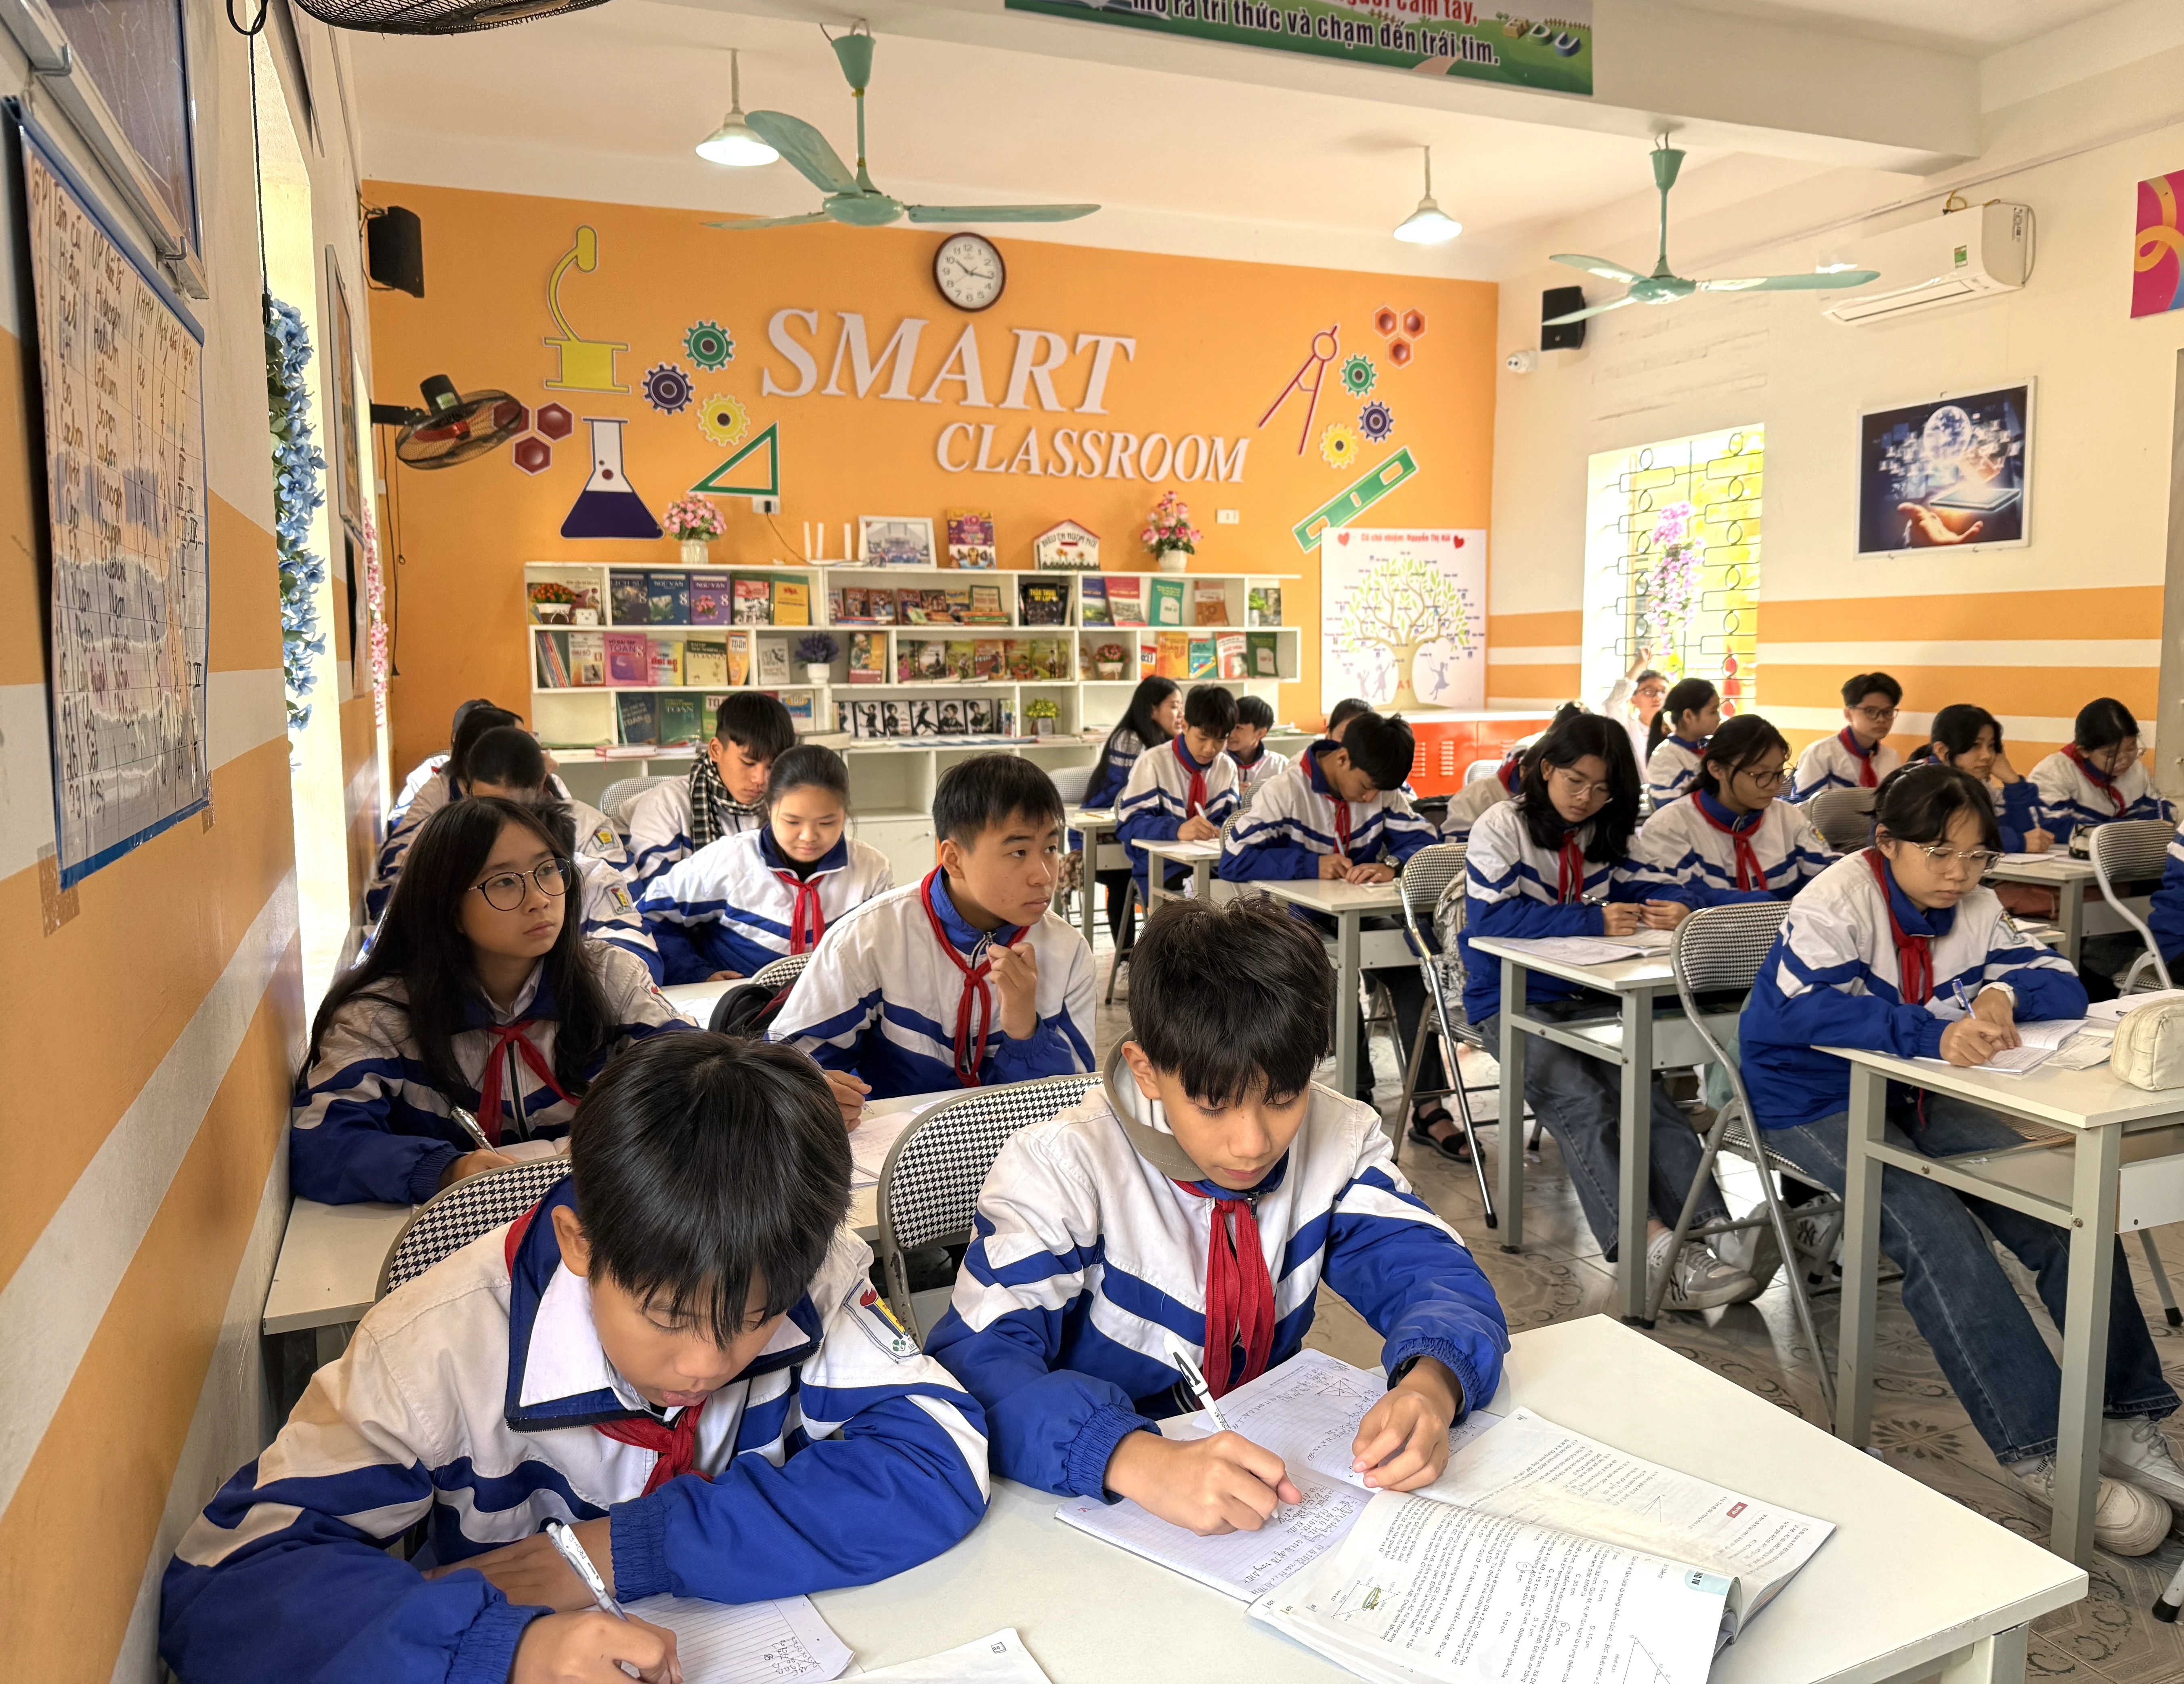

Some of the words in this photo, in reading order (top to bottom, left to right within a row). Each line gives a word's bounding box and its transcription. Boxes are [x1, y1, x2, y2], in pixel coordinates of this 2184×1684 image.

[1173, 0, 1196, 18] ra
[1233, 1, 1281, 31] thức
[1287, 8, 1311, 35] và
[1317, 15, 1372, 48] chạm
[1381, 21, 1415, 50] đến
[1422, 31, 1455, 57] trái
[1462, 39, 1499, 64] tim.
[1504, 17, 1581, 57] EDU
[953, 247, 961, 255] 11
[955, 290, 961, 298] 7
[138, 325, 144, 351] H
[762, 308, 1136, 415] SMART
[938, 422, 1250, 484] CLASSROOM
[638, 592, 647, 604] 8
[679, 592, 687, 605] 8
[721, 594, 729, 606] 8
[636, 645, 644, 658] 8
[1460, 1538, 1471, 1552] Chứng
[1444, 1584, 1452, 1595] điểm
[1614, 1594, 1623, 1606] trung
[1430, 1611, 1441, 1623] thẳng
[1569, 1645, 1578, 1658] trung
[1565, 1659, 1573, 1672] điểm
[1596, 1667, 1603, 1676] HK
